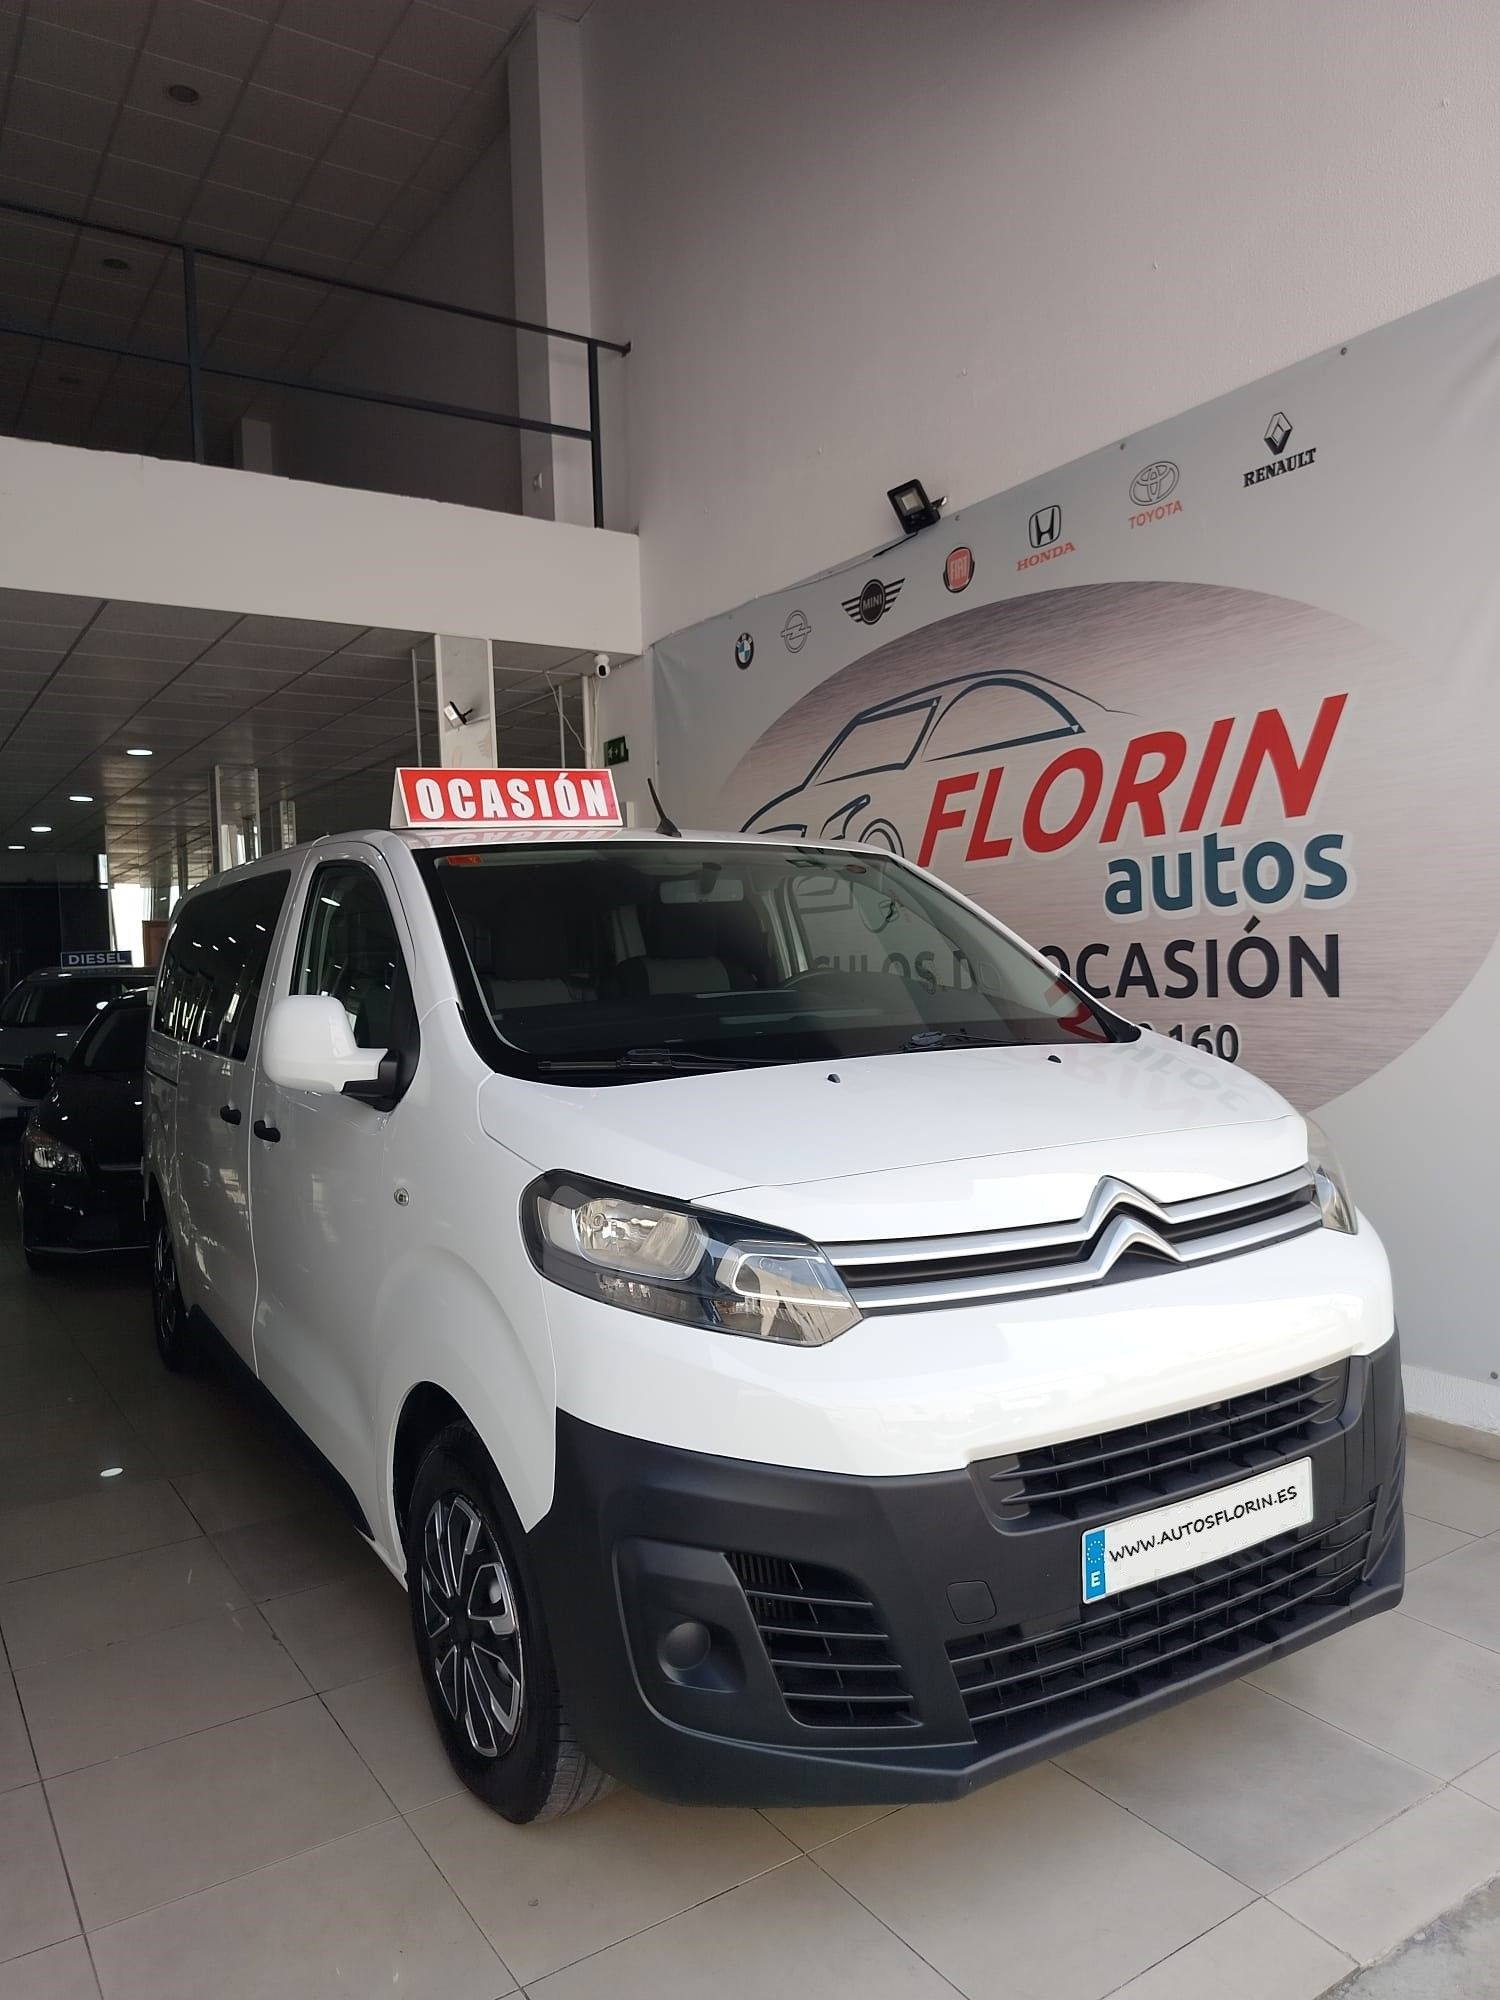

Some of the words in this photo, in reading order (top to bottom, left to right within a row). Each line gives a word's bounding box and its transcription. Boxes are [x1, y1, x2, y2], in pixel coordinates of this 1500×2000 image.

[1242, 448, 1317, 488] RENAULT
[1128, 500, 1184, 530] TOYOTA
[1016, 542, 1076, 571] HONDA
[863, 594, 882, 610] MINI
[415, 773, 609, 820] OCASIÓN
[917, 693, 1349, 868] FLORIN
[1104, 832, 1348, 914] autos
[68, 953, 126, 965] DIESEL
[1108, 1486, 1298, 1562] WWW.AUTOSFLORIN.ES
[1091, 1571, 1101, 1588] E
